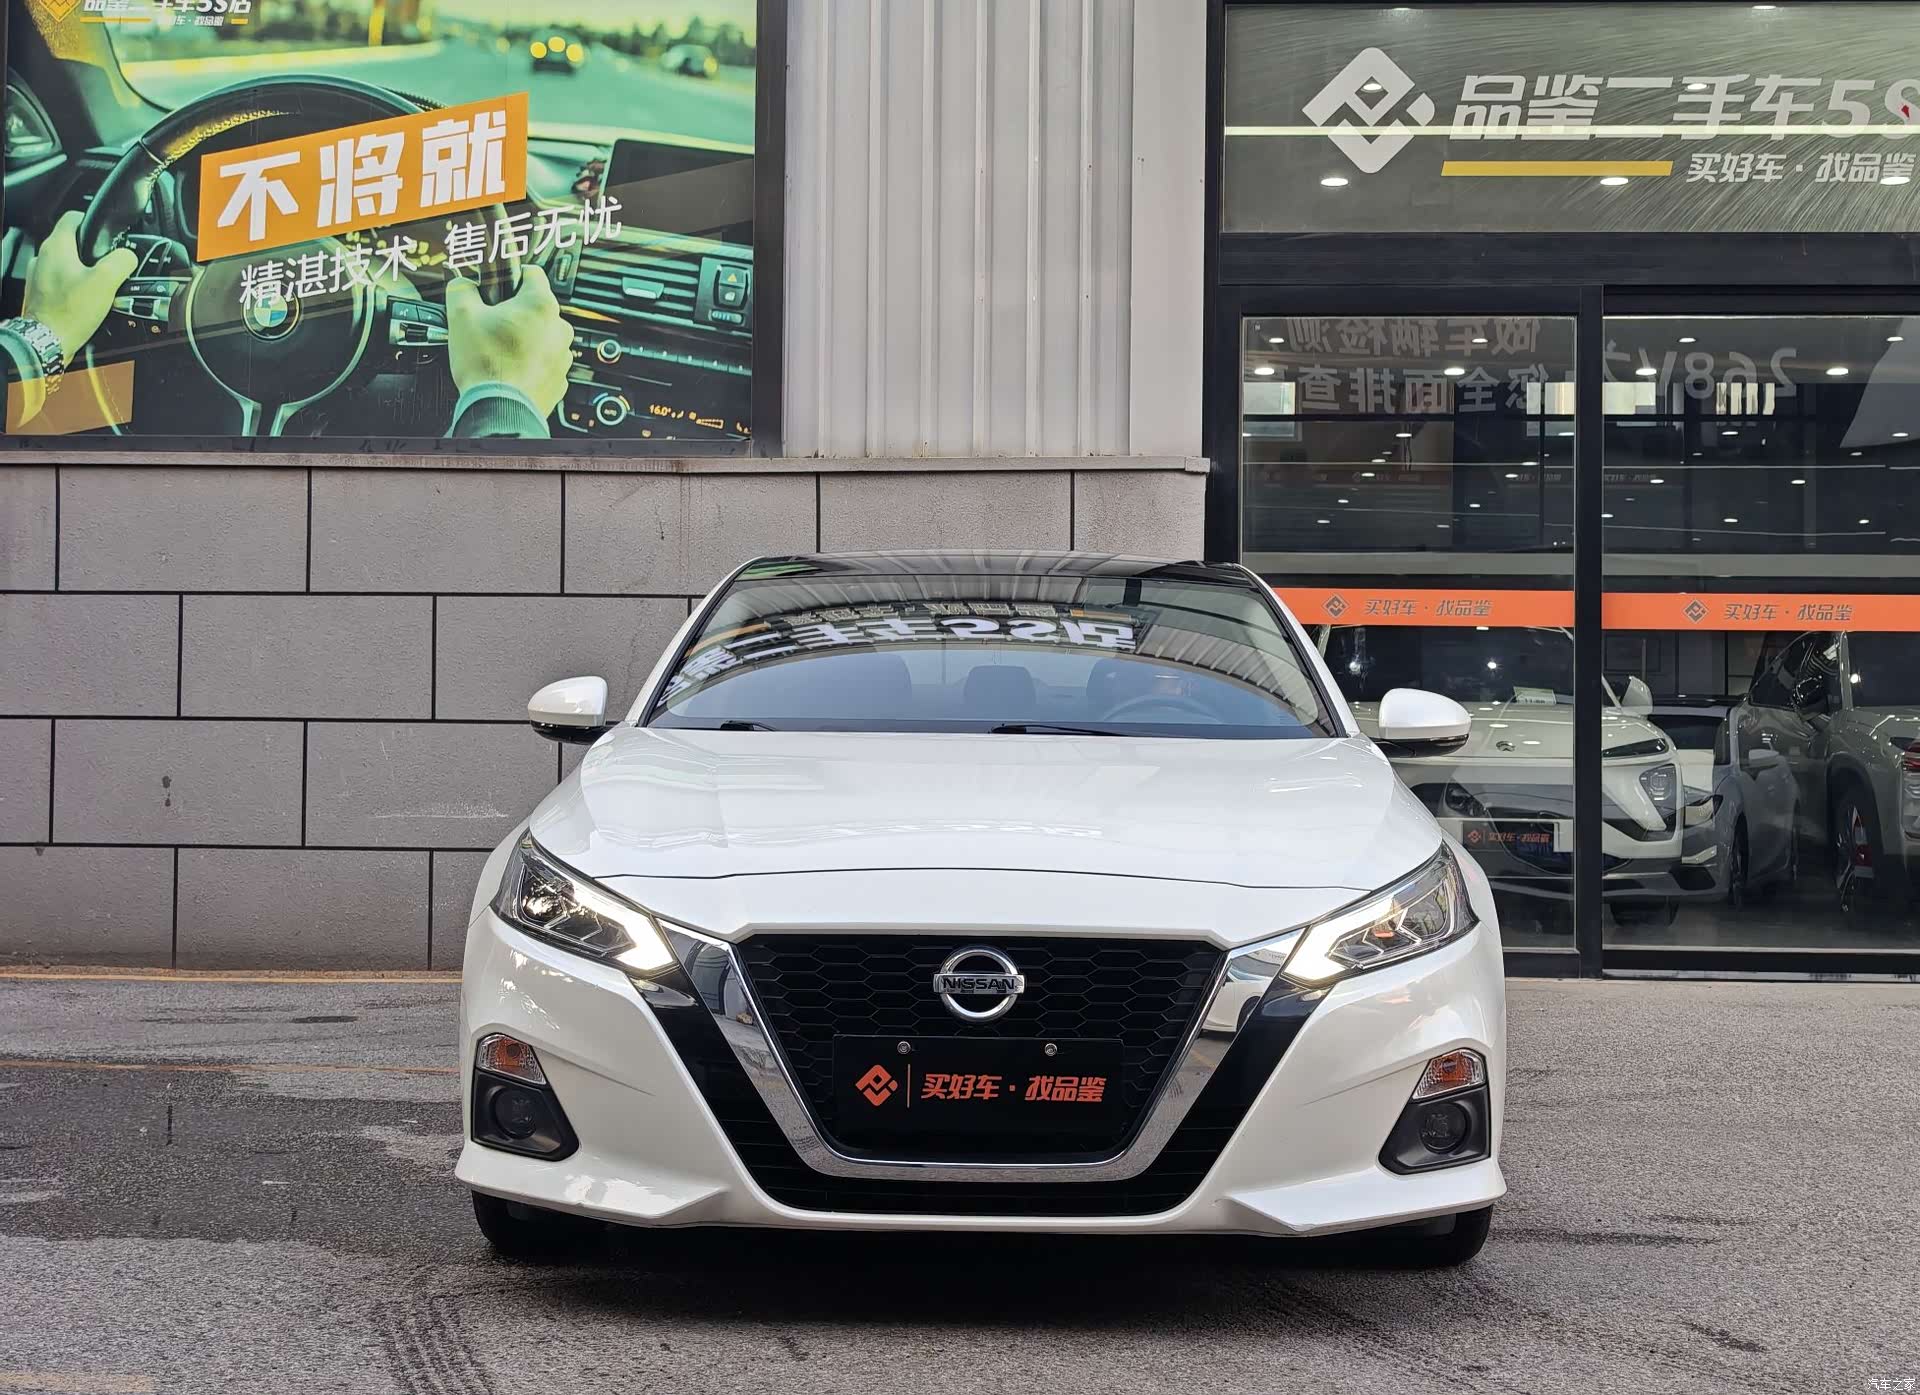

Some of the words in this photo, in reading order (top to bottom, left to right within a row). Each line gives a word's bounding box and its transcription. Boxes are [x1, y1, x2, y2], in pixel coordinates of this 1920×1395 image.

[217, 110, 506, 241] 不将就
[240, 235, 418, 310] 精湛技术
[444, 195, 622, 268] 售后无忧
[943, 977, 1015, 990] NISSAN
